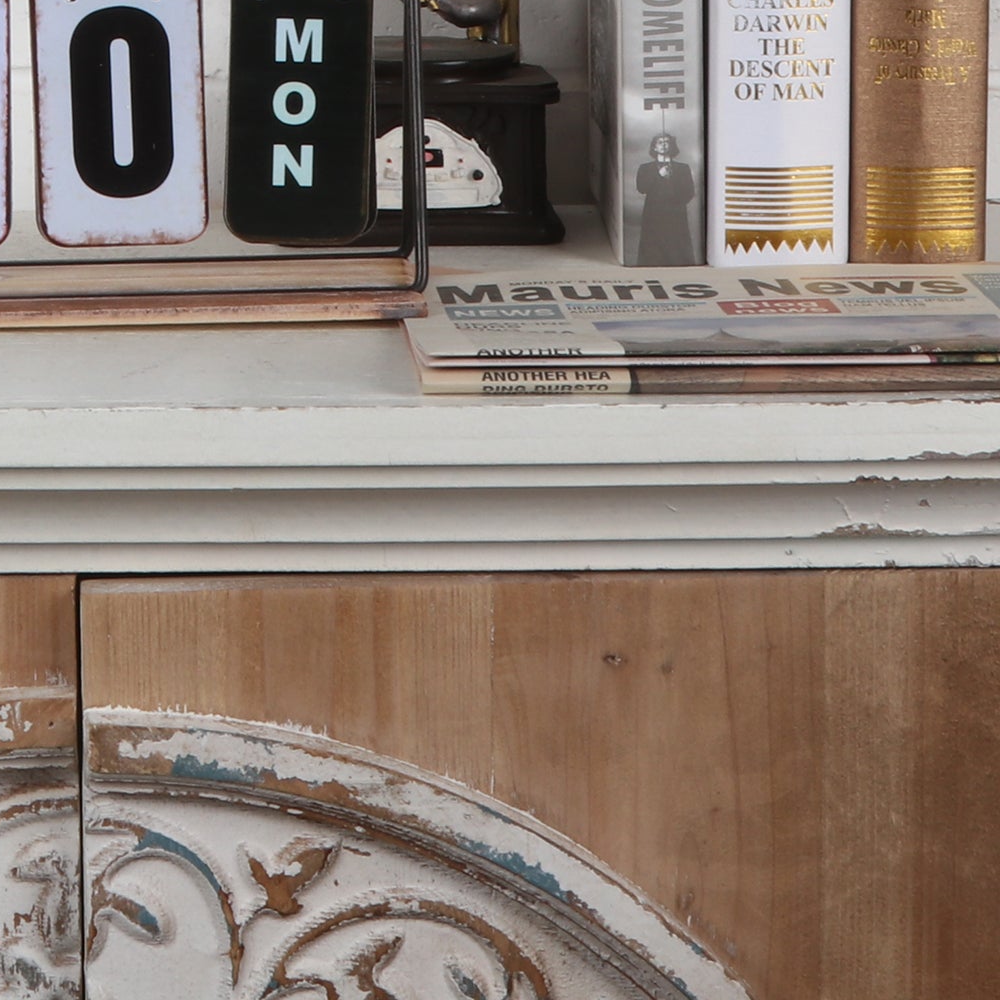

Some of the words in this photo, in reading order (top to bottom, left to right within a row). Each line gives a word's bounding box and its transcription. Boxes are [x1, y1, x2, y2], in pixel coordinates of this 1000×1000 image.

[733, 13, 829, 33] DARWIN
[758, 37, 806, 57] THE
[729, 58, 835, 79] DESCENT
[734, 82, 767, 101] OF
[772, 82, 826, 101] MAN
[271, 17, 324, 188] MON
[436, 279, 719, 305] Mauris
[737, 278, 969, 297] News
[453, 307, 556, 318] NEWS
[477, 347, 583, 357] ANOTHER
[481, 371, 568, 382] ANOTHER
[574, 370, 611, 381] HEA
